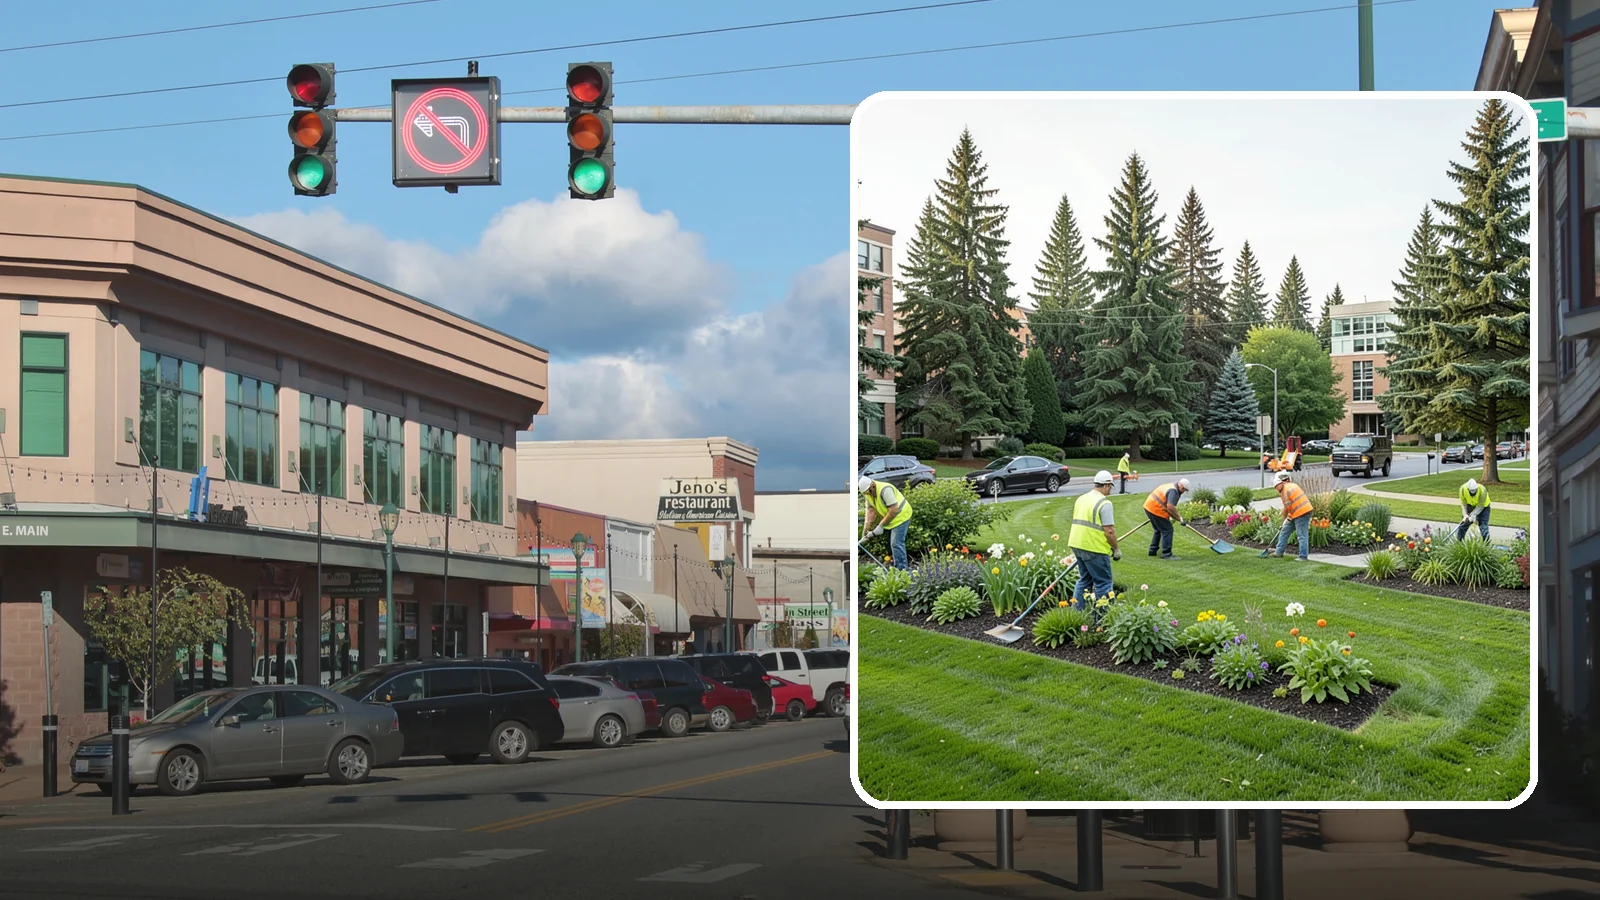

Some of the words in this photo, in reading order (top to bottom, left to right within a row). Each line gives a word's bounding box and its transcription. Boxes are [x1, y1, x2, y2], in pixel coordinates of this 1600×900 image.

[669, 480, 727, 494] Jeno's
[665, 496, 731, 509] restaurant
[658, 510, 681, 519] Italian
[686, 510, 714, 519] American
[715, 509, 737, 519] Cuisine
[2, 525, 13, 536] E.
[15, 525, 49, 536] MAIN
[797, 607, 829, 617] Street
